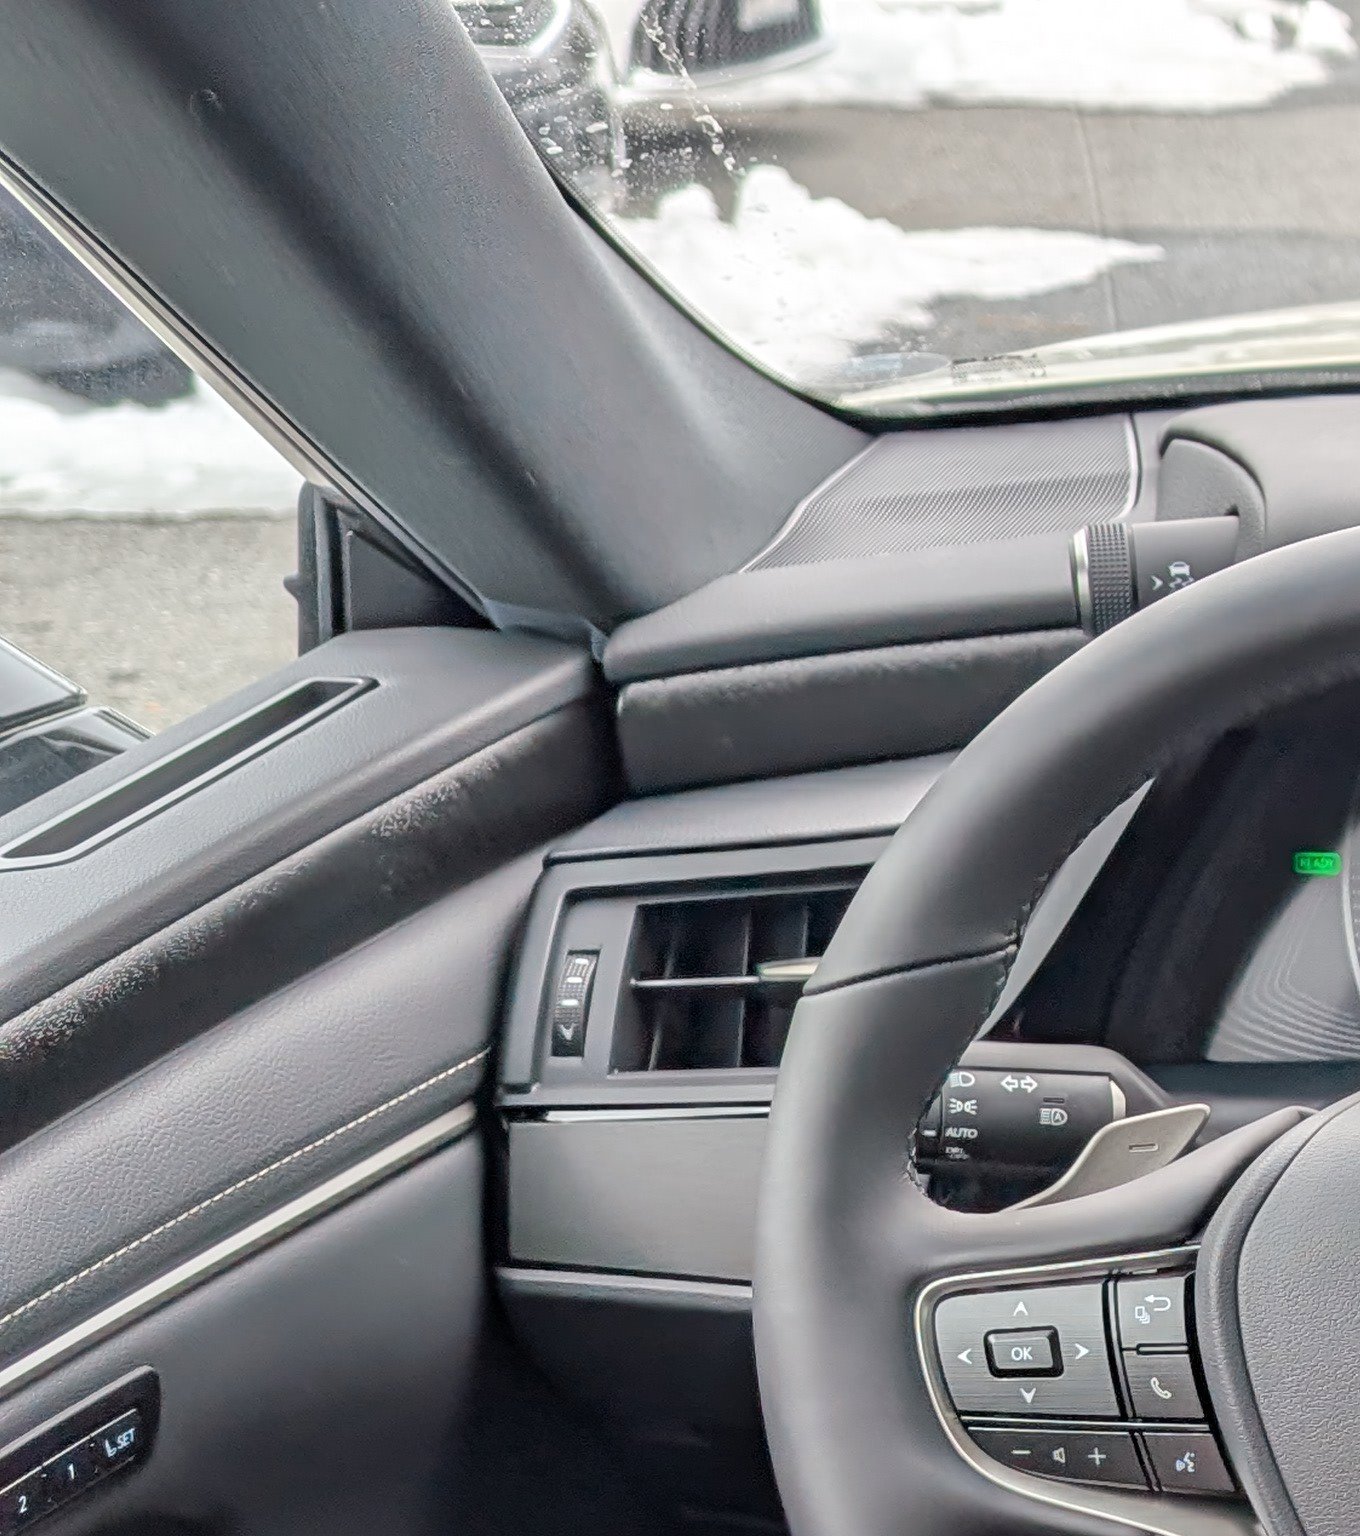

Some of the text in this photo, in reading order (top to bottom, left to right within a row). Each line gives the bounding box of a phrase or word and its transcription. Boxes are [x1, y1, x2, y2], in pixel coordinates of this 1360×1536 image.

[945, 1127, 979, 1139] AUTO
[1011, 1347, 1033, 1361] OK
[117, 1428, 136, 1450] SET
[67, 1462, 76, 1480] 1
[18, 1495, 28, 1514] 2
